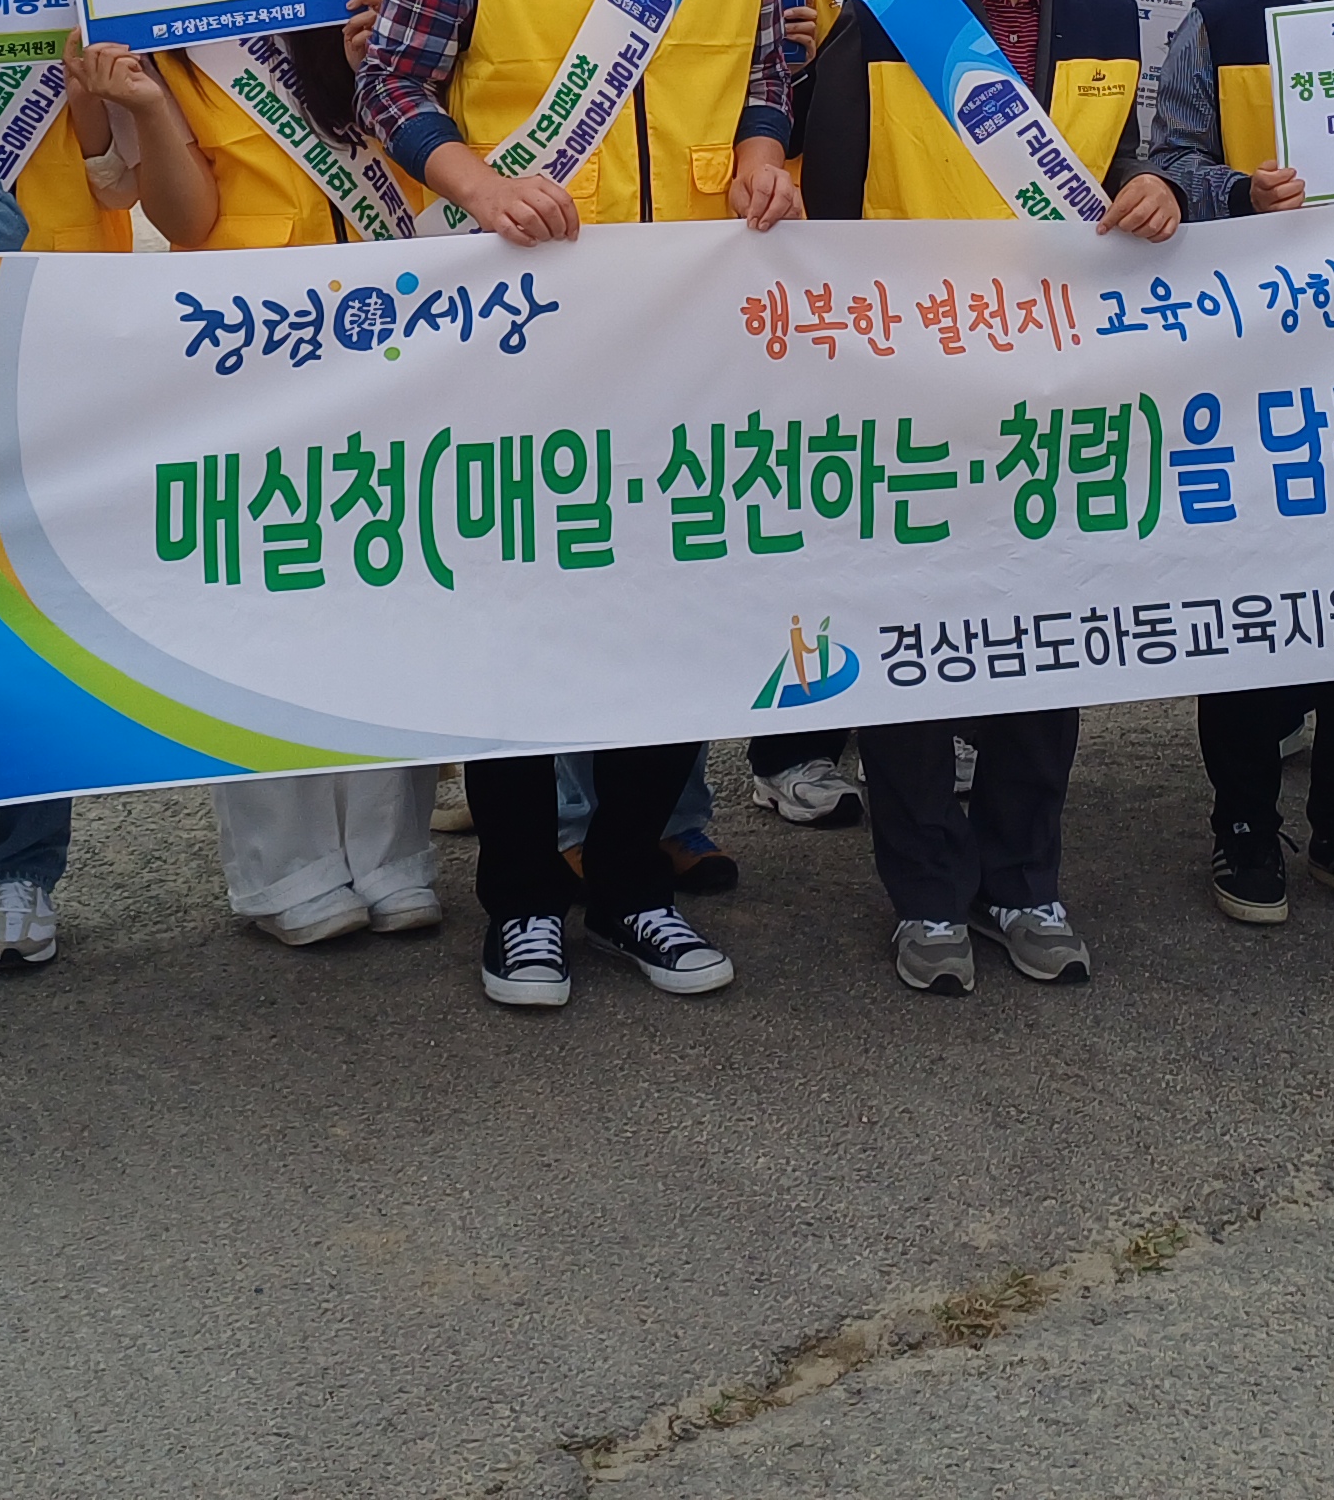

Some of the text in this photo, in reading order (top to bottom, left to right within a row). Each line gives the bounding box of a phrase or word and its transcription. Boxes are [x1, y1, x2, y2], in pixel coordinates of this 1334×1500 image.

[170, 2, 306, 36] 경상남도하동교육지원청
[230, 67, 313, 149] 청렴한
[302, 140, 359, 201] 문화
[526, 52, 601, 151] 청렴한
[542, 29, 650, 185] 교육공동체
[738, 281, 903, 361] 행복한
[915, 276, 1081, 357] 별천지!
[1095, 268, 1244, 343] 교육이
